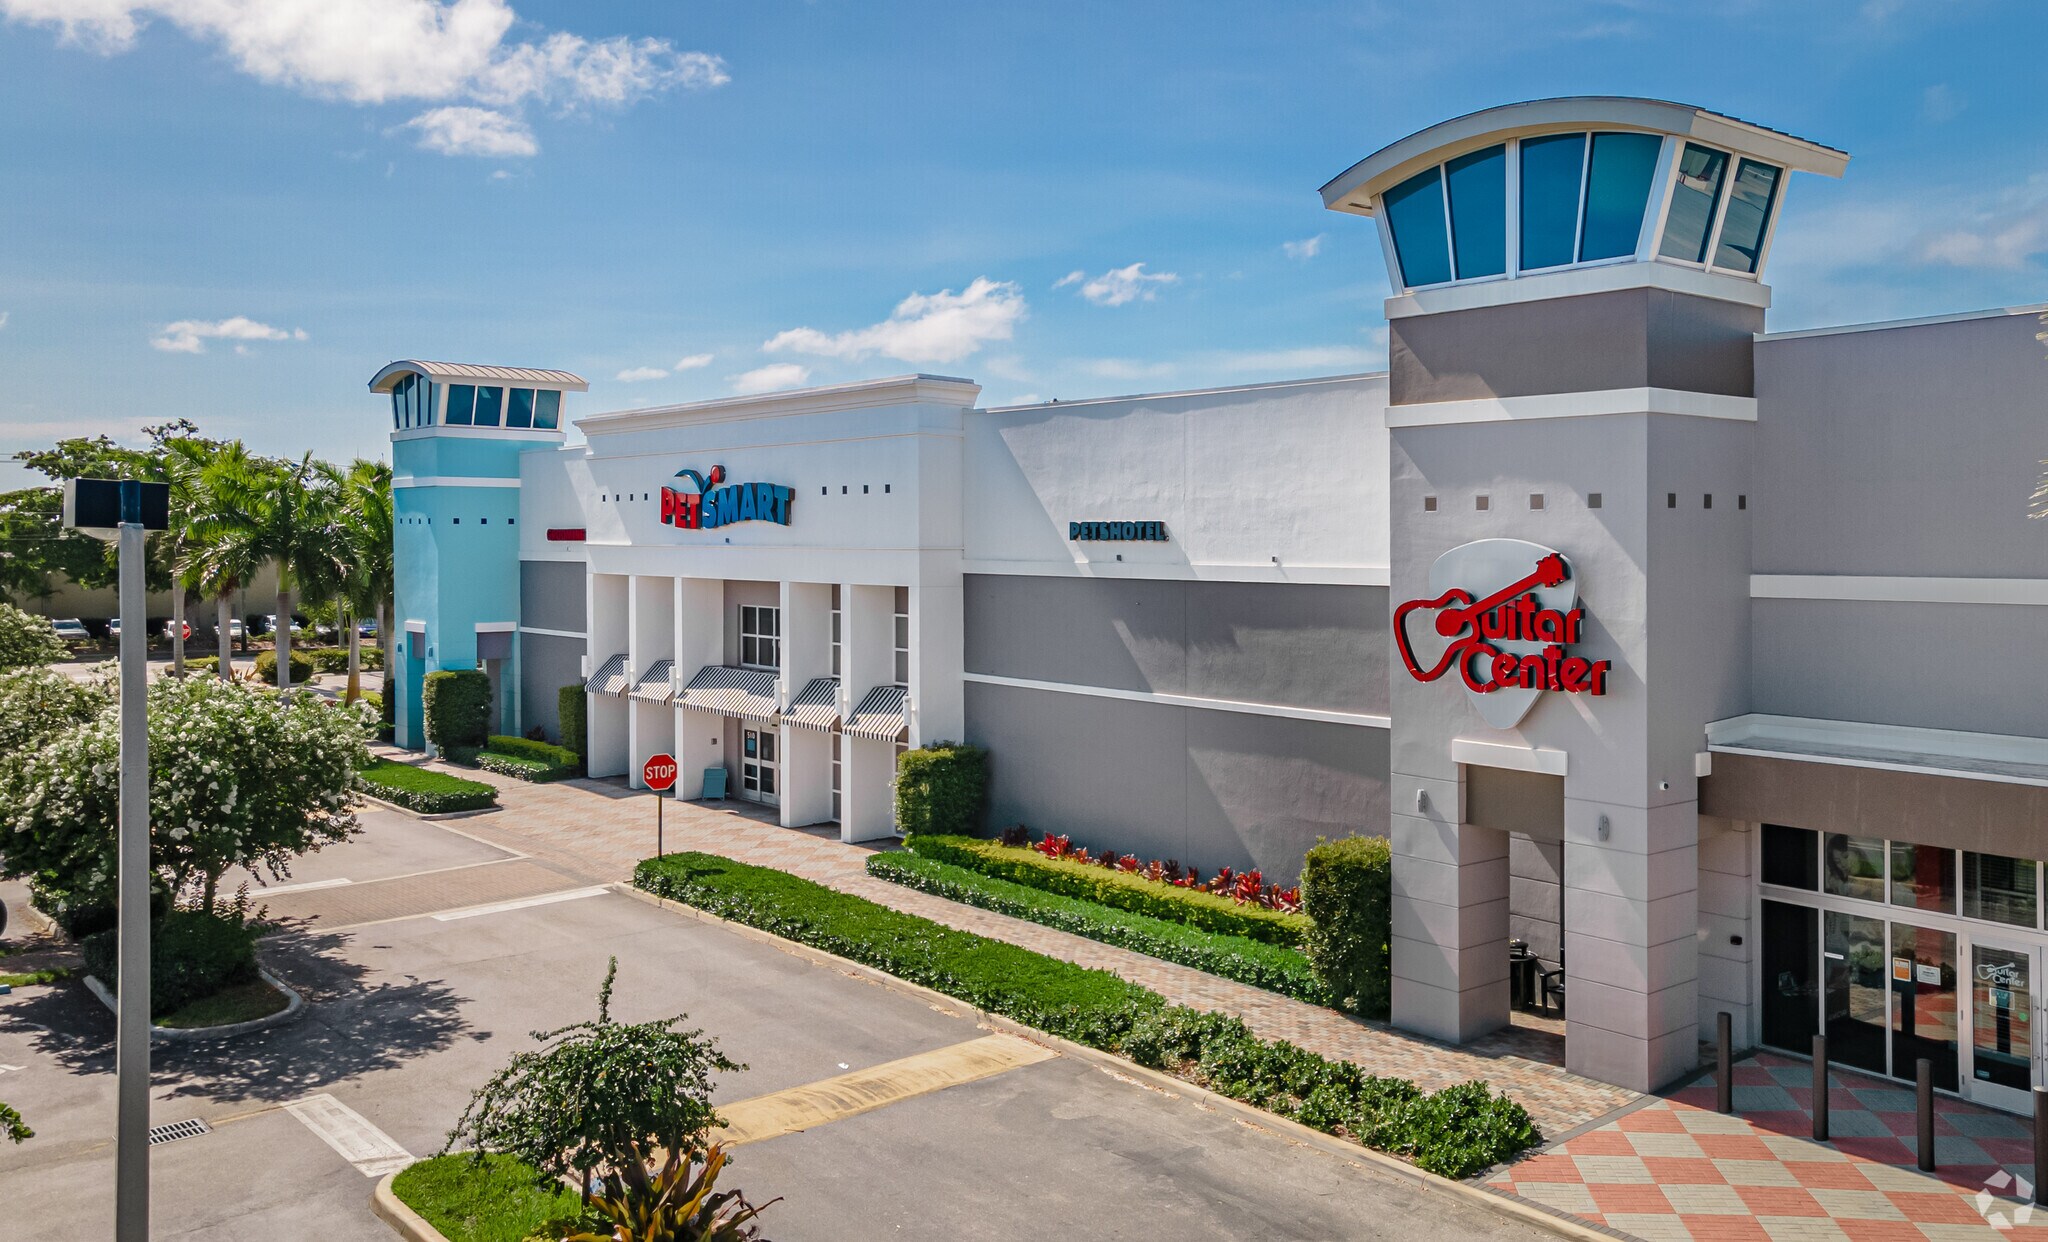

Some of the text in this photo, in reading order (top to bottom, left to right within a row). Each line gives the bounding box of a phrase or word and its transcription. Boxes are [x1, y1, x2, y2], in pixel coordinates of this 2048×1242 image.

[1069, 521, 1166, 541] PETSHOTEL
[1460, 644, 1611, 695] Center
[645, 764, 676, 780] STOP
[1993, 974, 2025, 987] Center
